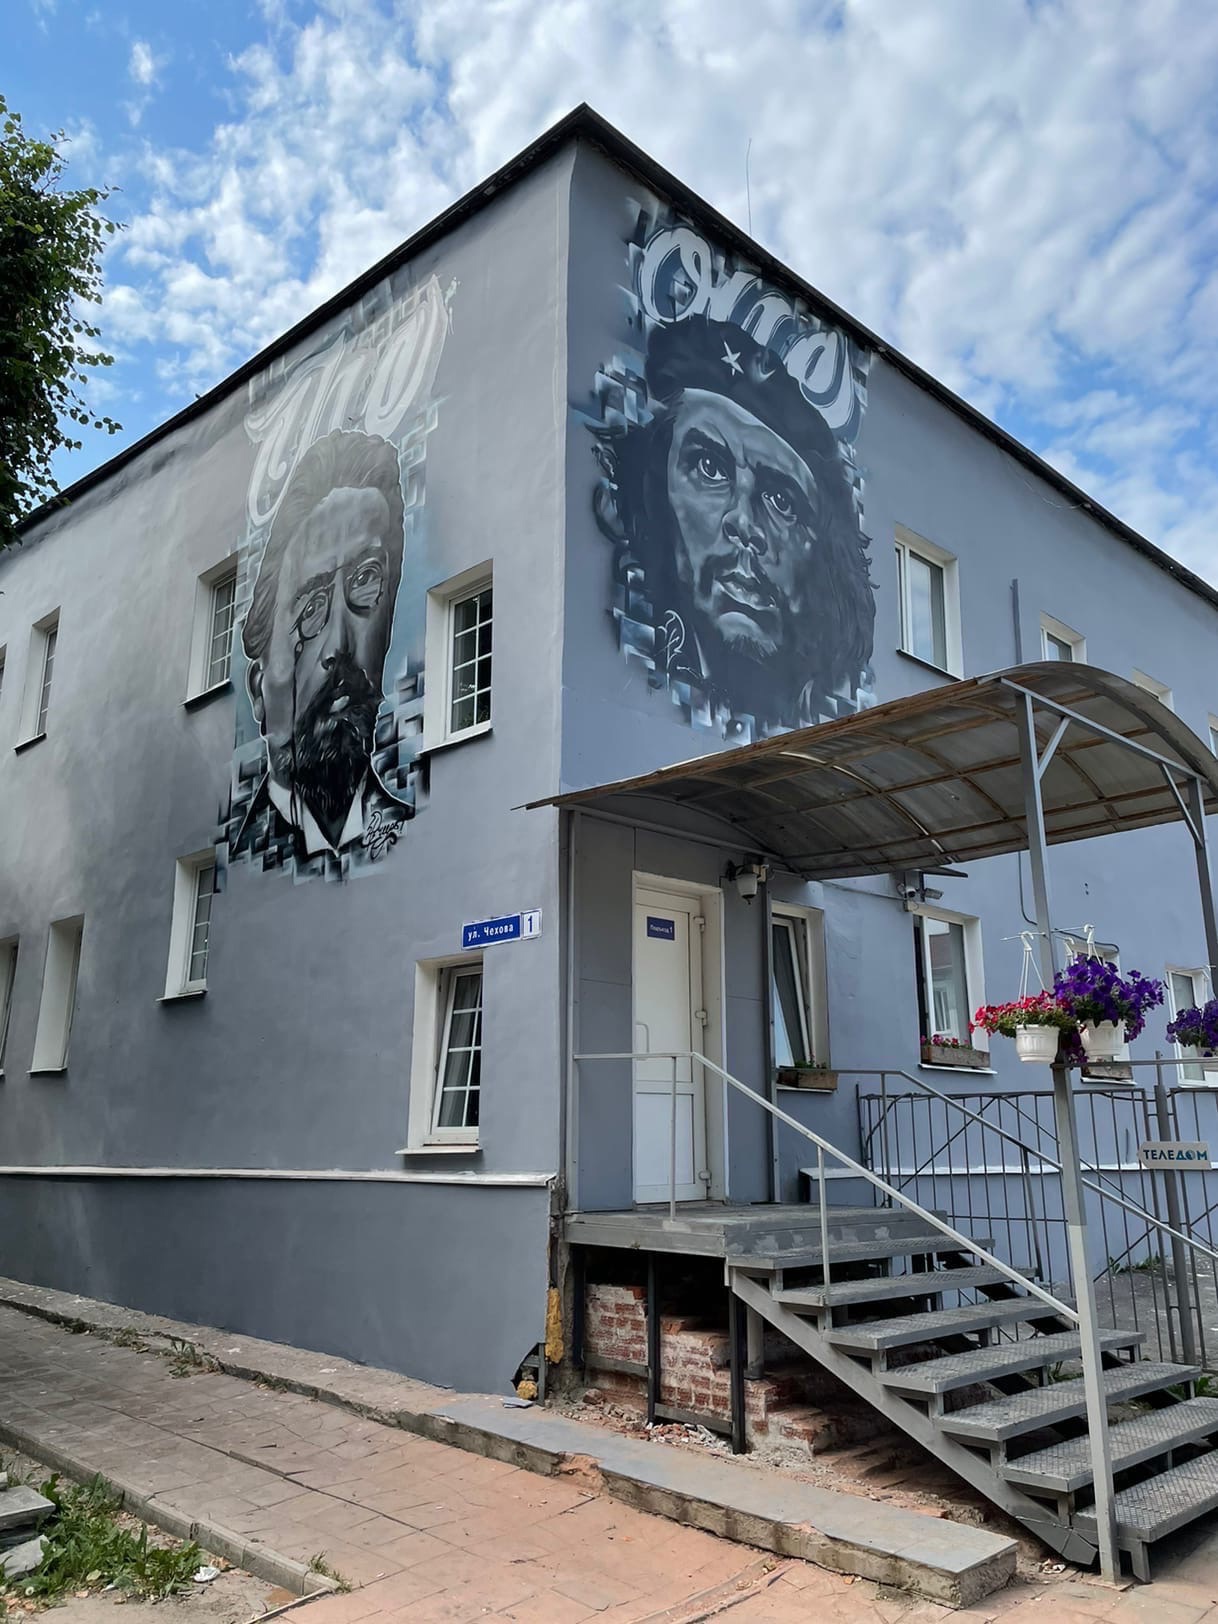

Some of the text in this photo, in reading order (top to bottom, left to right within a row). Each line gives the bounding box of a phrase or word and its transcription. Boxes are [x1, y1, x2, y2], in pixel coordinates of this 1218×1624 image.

[467, 923, 514, 942] ул. Чехова
[527, 915, 533, 933] 1
[1143, 1149, 1208, 1161] ТЕЛЕДОМ
